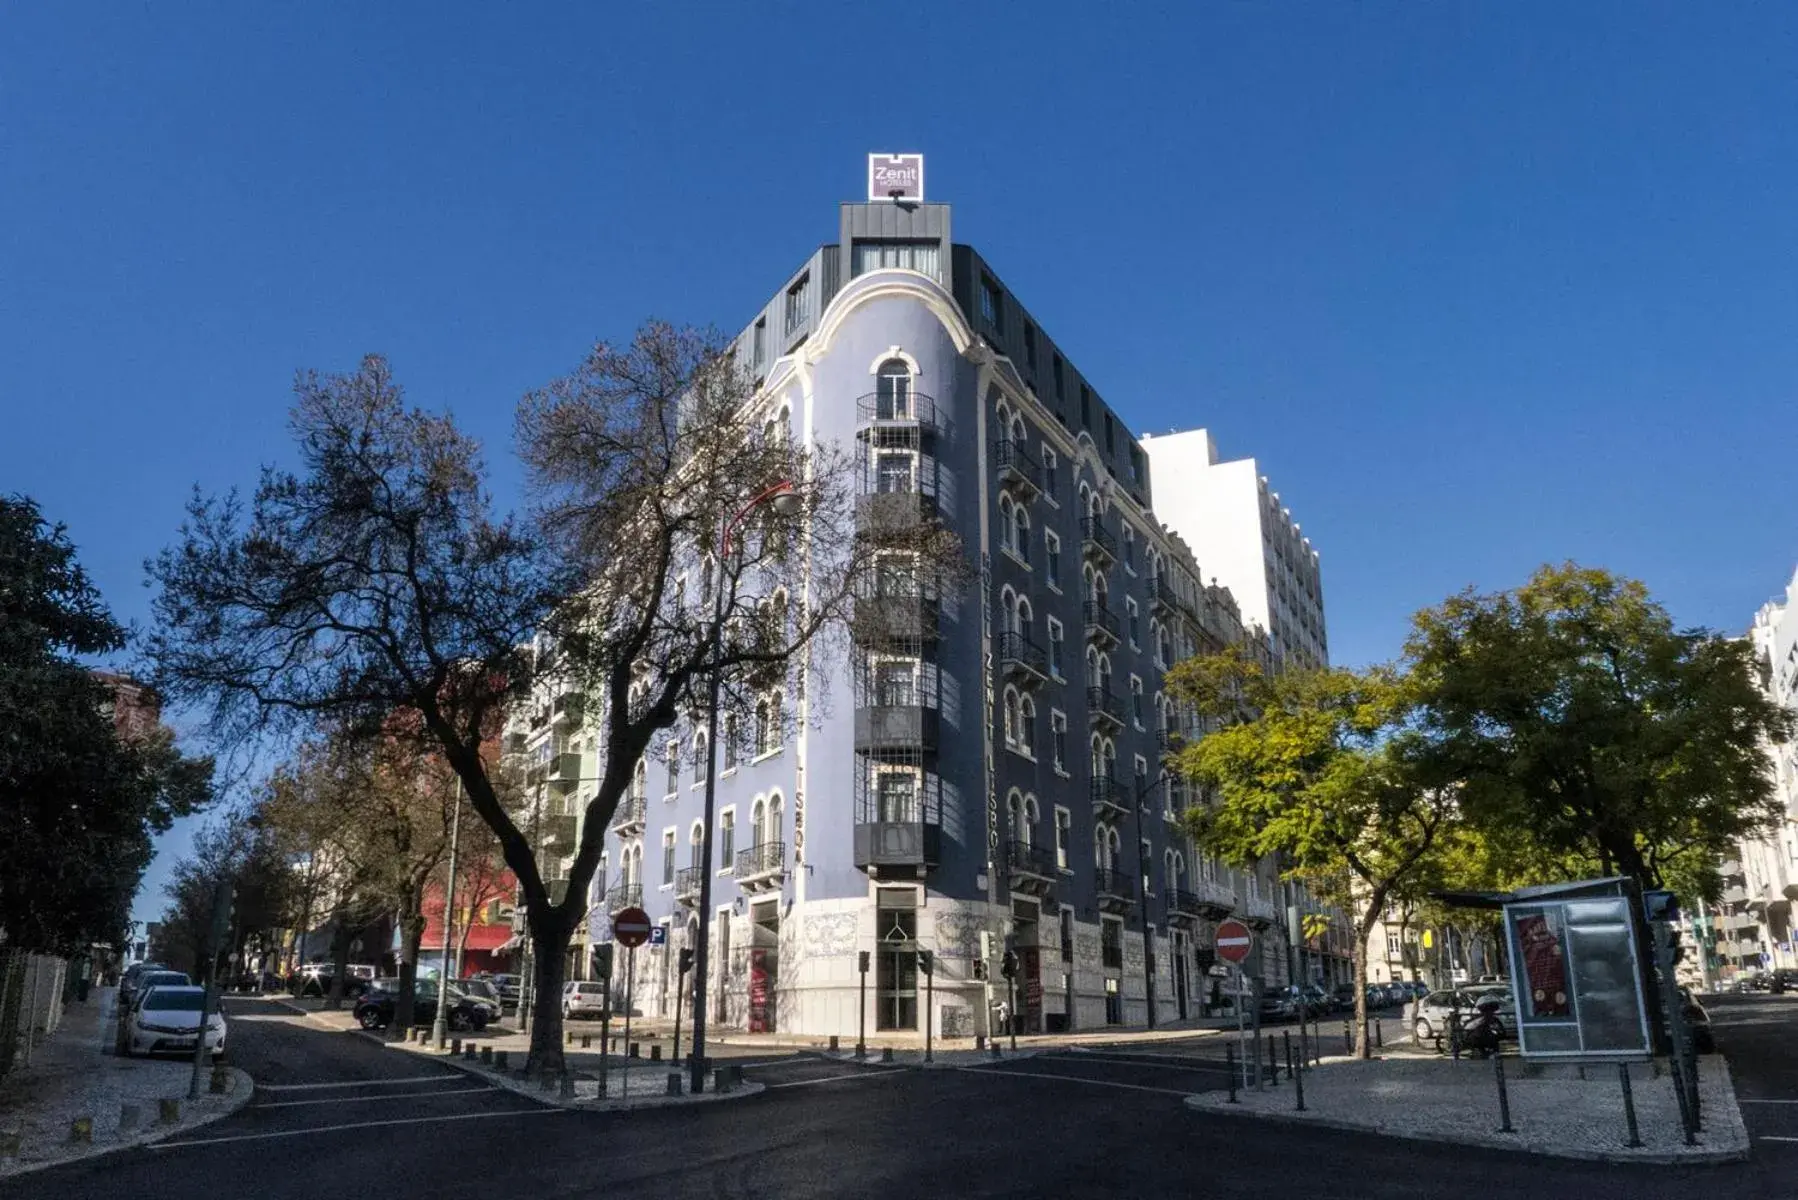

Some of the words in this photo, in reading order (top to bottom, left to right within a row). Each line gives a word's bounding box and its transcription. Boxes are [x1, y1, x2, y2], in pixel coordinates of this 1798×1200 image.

[875, 166, 917, 180] Zenit
[986, 652, 994, 741] ZENIT
[652, 928, 662, 941] P
